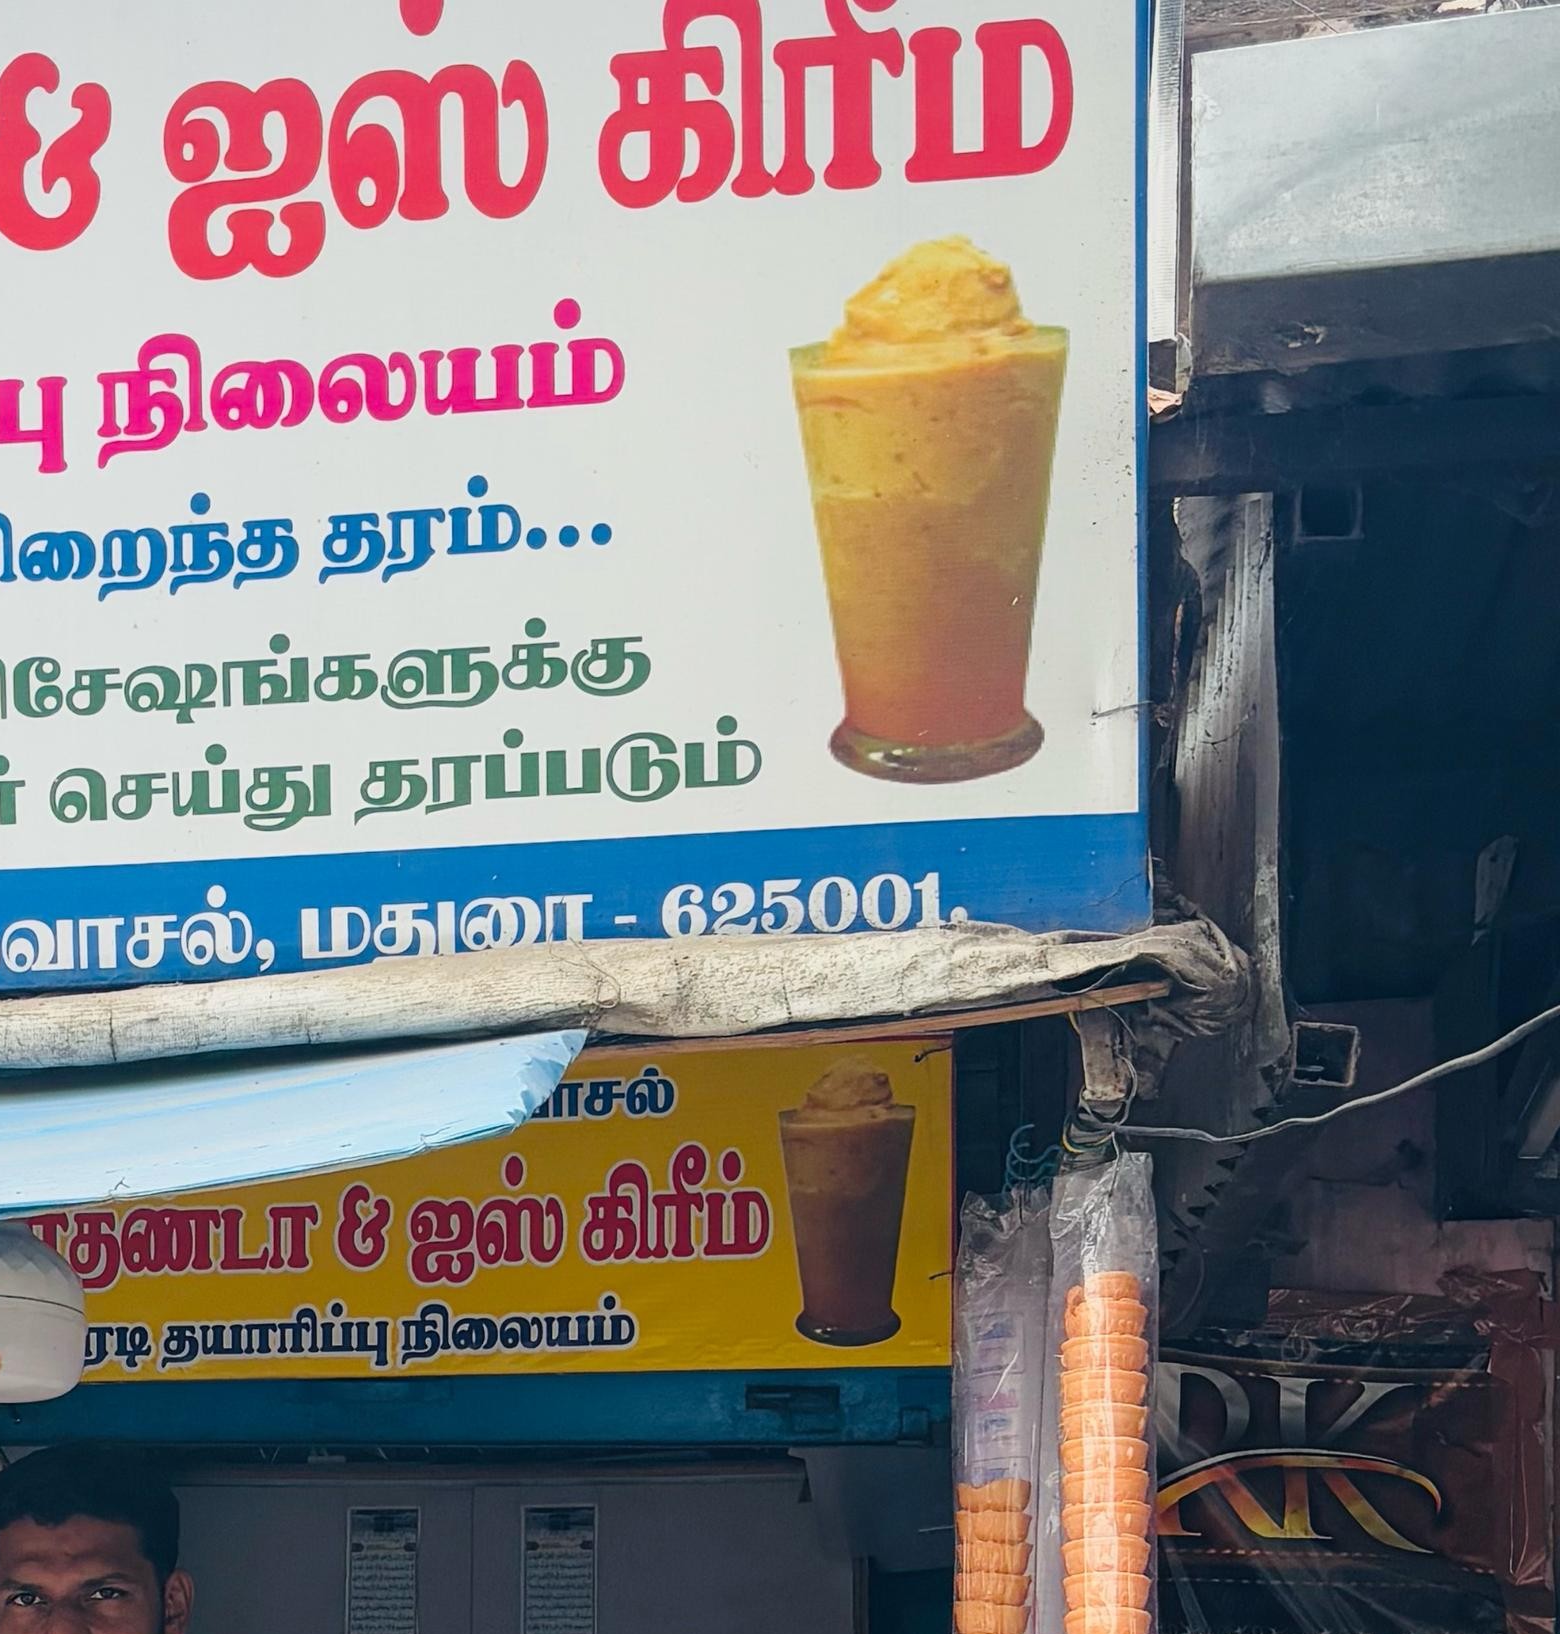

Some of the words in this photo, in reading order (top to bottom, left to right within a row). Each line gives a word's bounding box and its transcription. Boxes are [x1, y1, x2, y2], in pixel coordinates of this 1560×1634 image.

[163, 0, 547, 279] ஐஸ்
[97, 297, 625, 469] நிலையம்
[50, 743, 331, 832] செய்து
[355, 715, 762, 823] தரப்படும்
[300, 893, 593, 959] மதுரை
[338, 1185, 390, 1269] &
[412, 1155, 564, 1283] ஐஸ்
[582, 1143, 771, 1262] கிரீம்
[162, 1303, 387, 1368] தயாரிப்பு
[403, 1296, 636, 1365] நிலையம்
